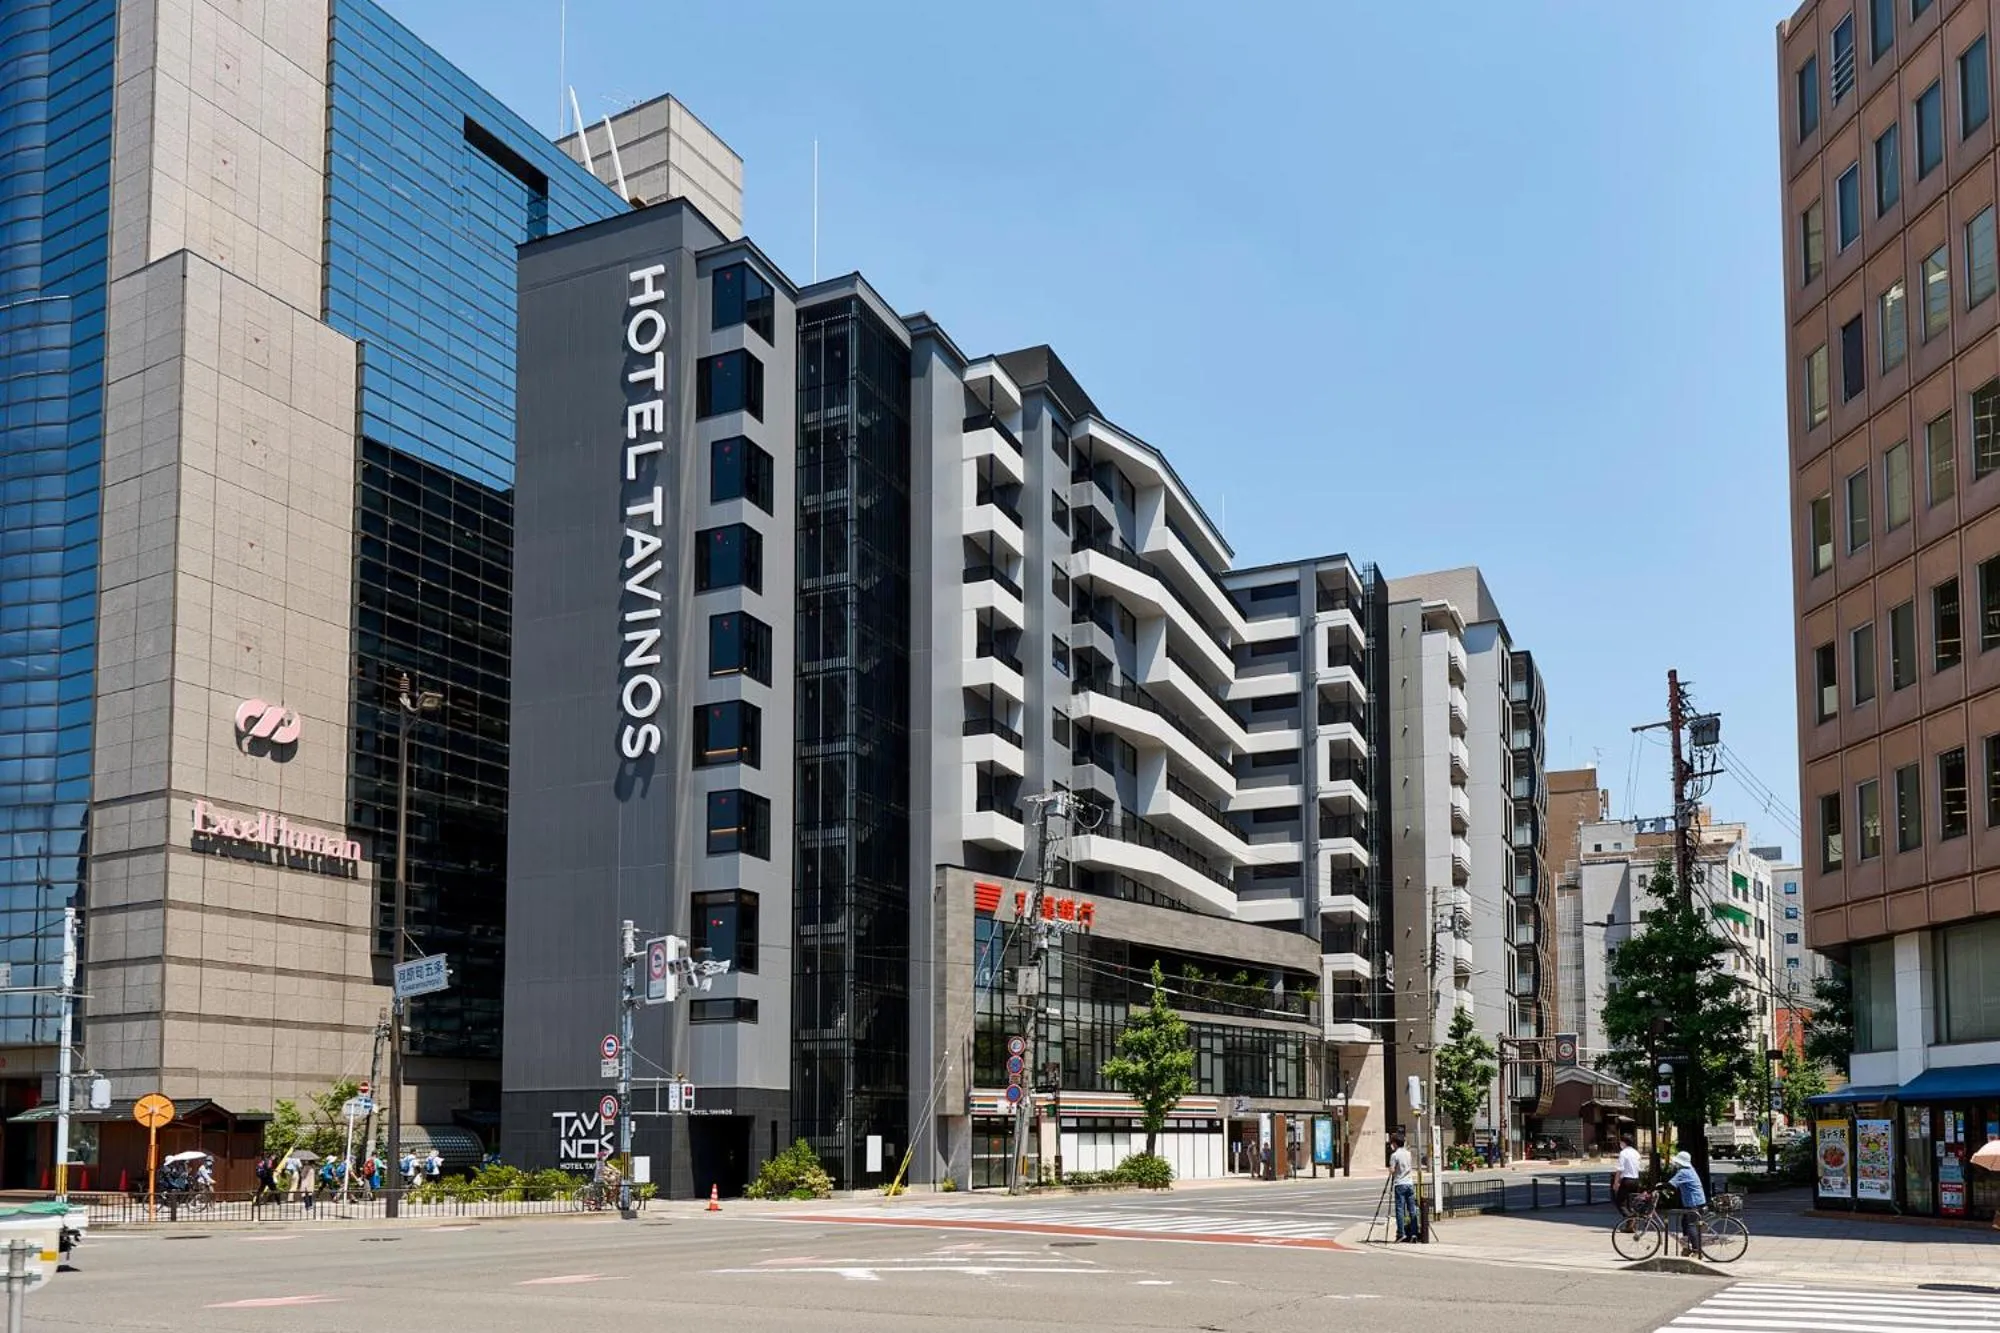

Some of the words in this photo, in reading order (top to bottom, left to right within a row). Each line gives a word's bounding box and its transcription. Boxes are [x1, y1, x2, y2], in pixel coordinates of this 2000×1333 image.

[626, 263, 666, 481] HOTEL
[621, 485, 663, 759] TAVINOS
[192, 799, 361, 861] ExcelHuman
